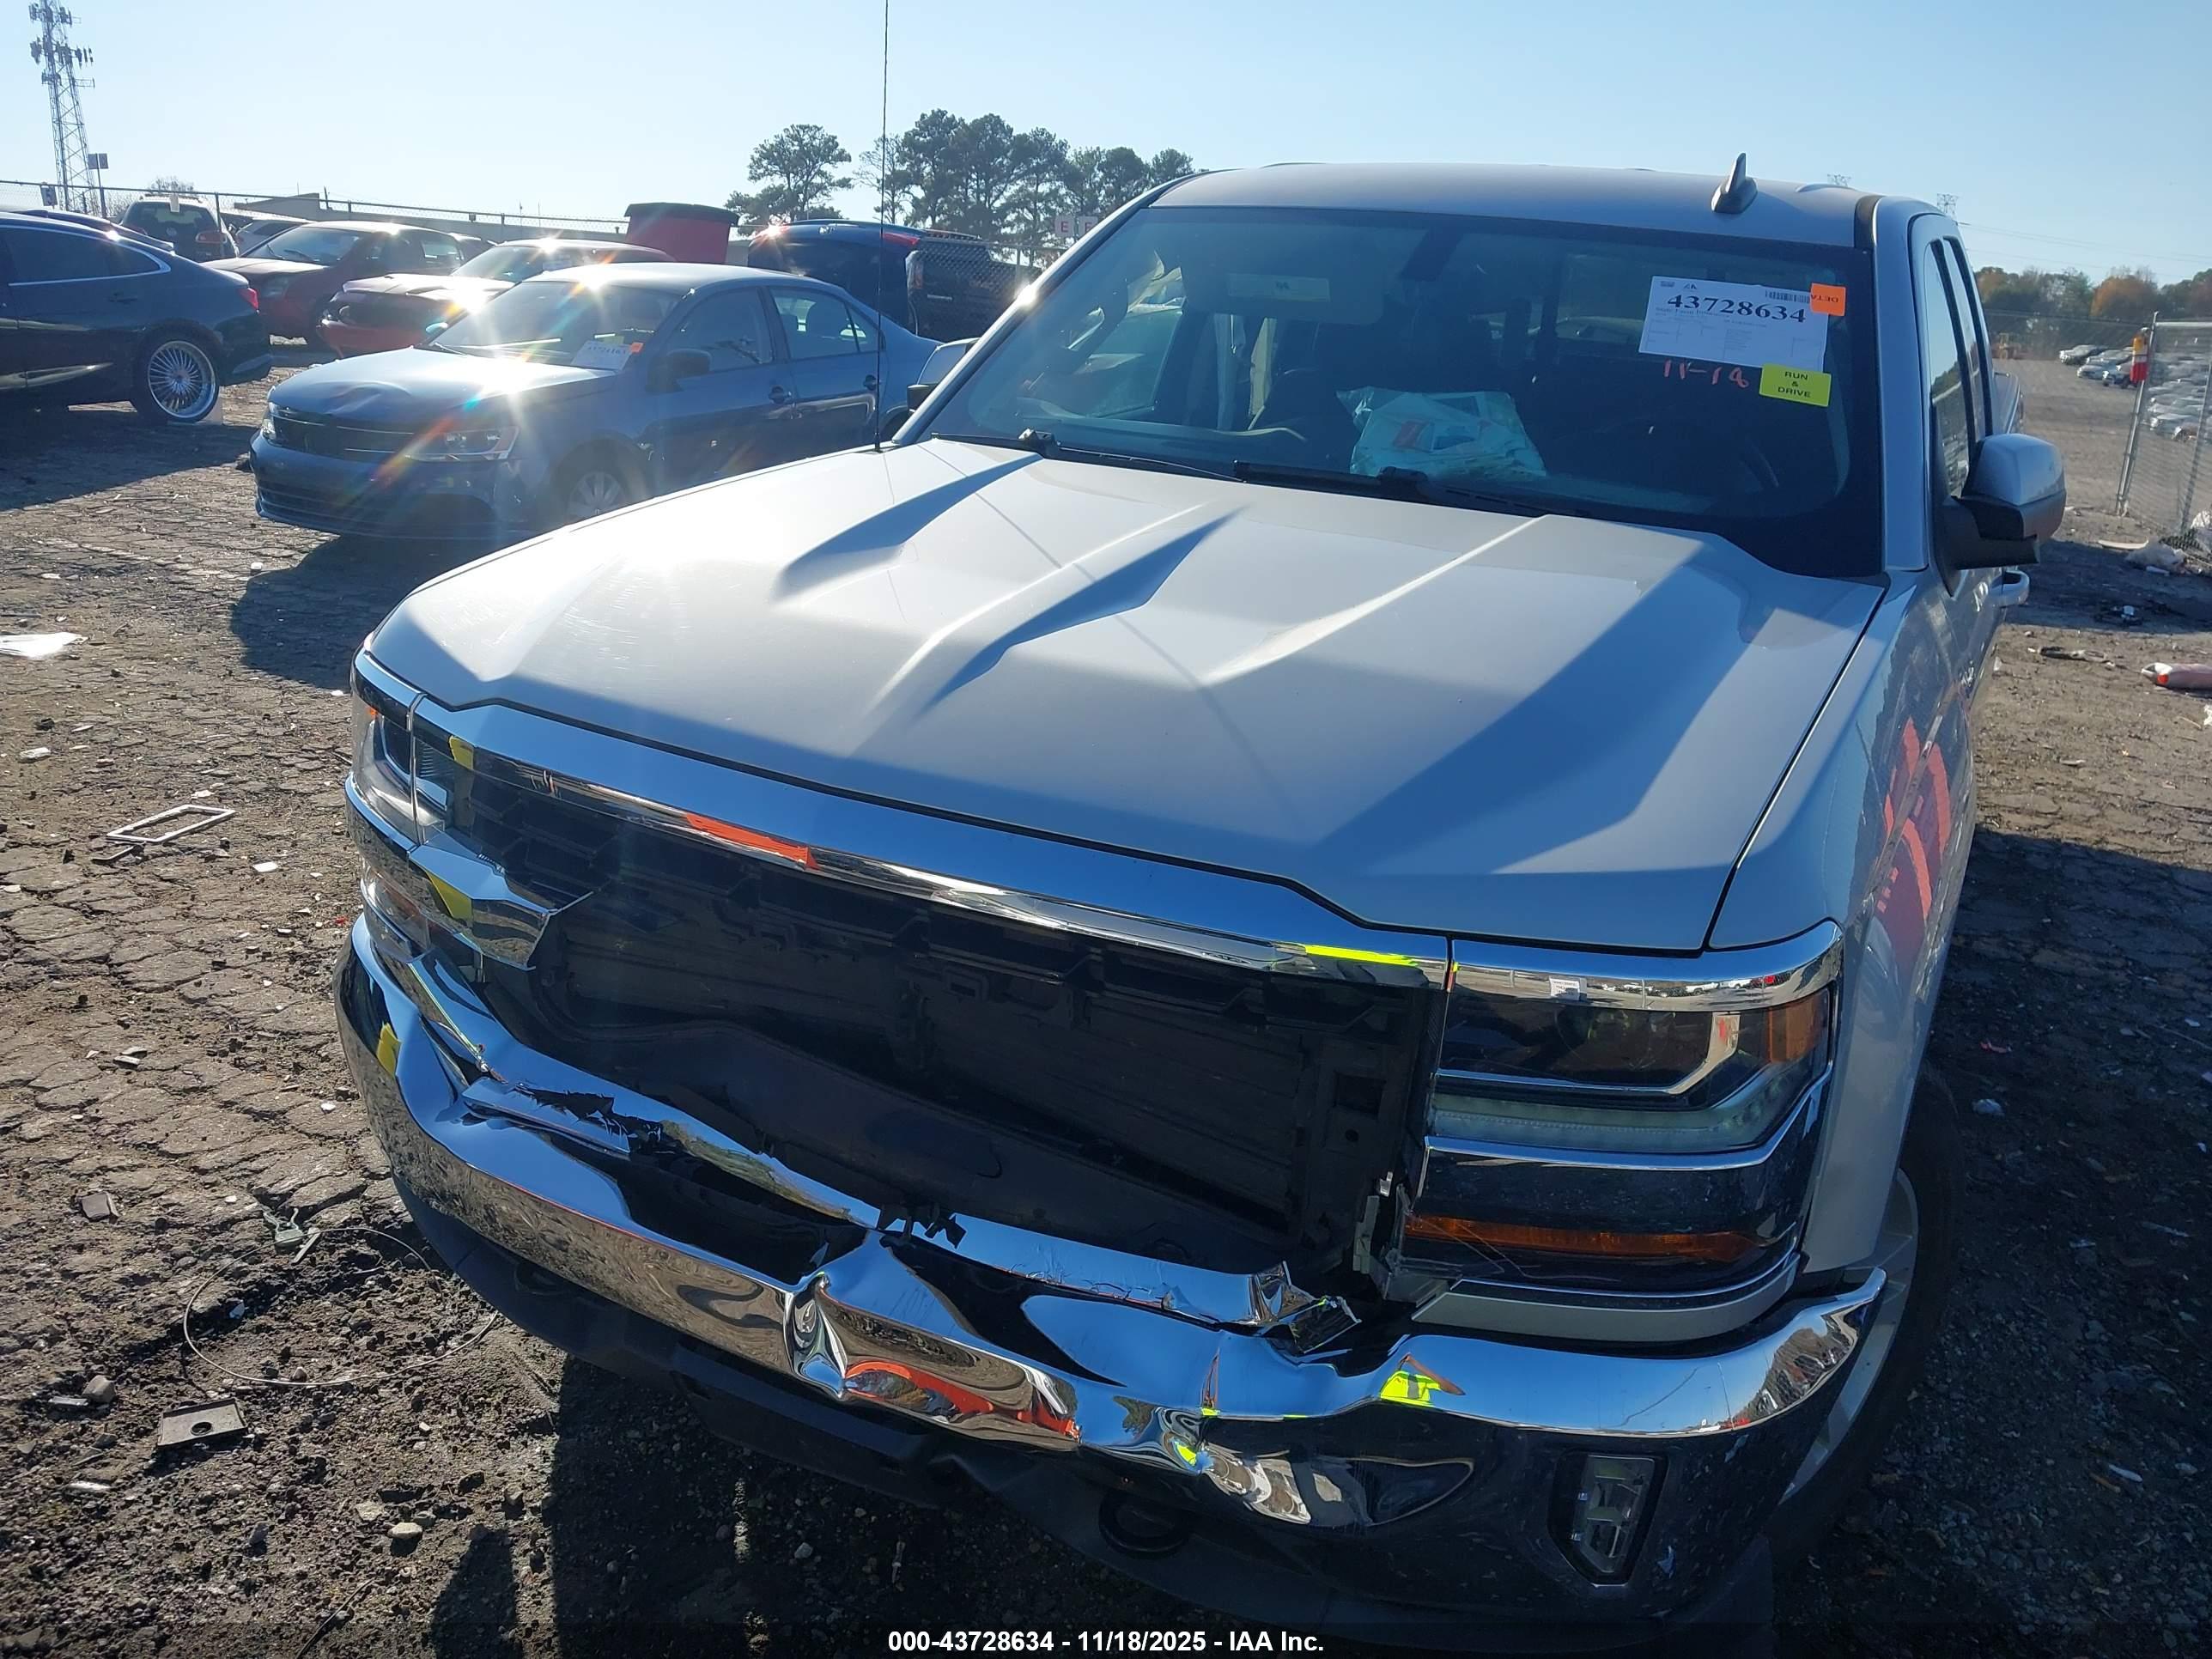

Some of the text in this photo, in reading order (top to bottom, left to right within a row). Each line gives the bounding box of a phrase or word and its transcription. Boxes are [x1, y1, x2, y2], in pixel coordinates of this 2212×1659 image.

[1667, 294, 1806, 323] 43728634
[1784, 371, 1808, 380] RUN
[1778, 386, 1812, 398] DRIVE
